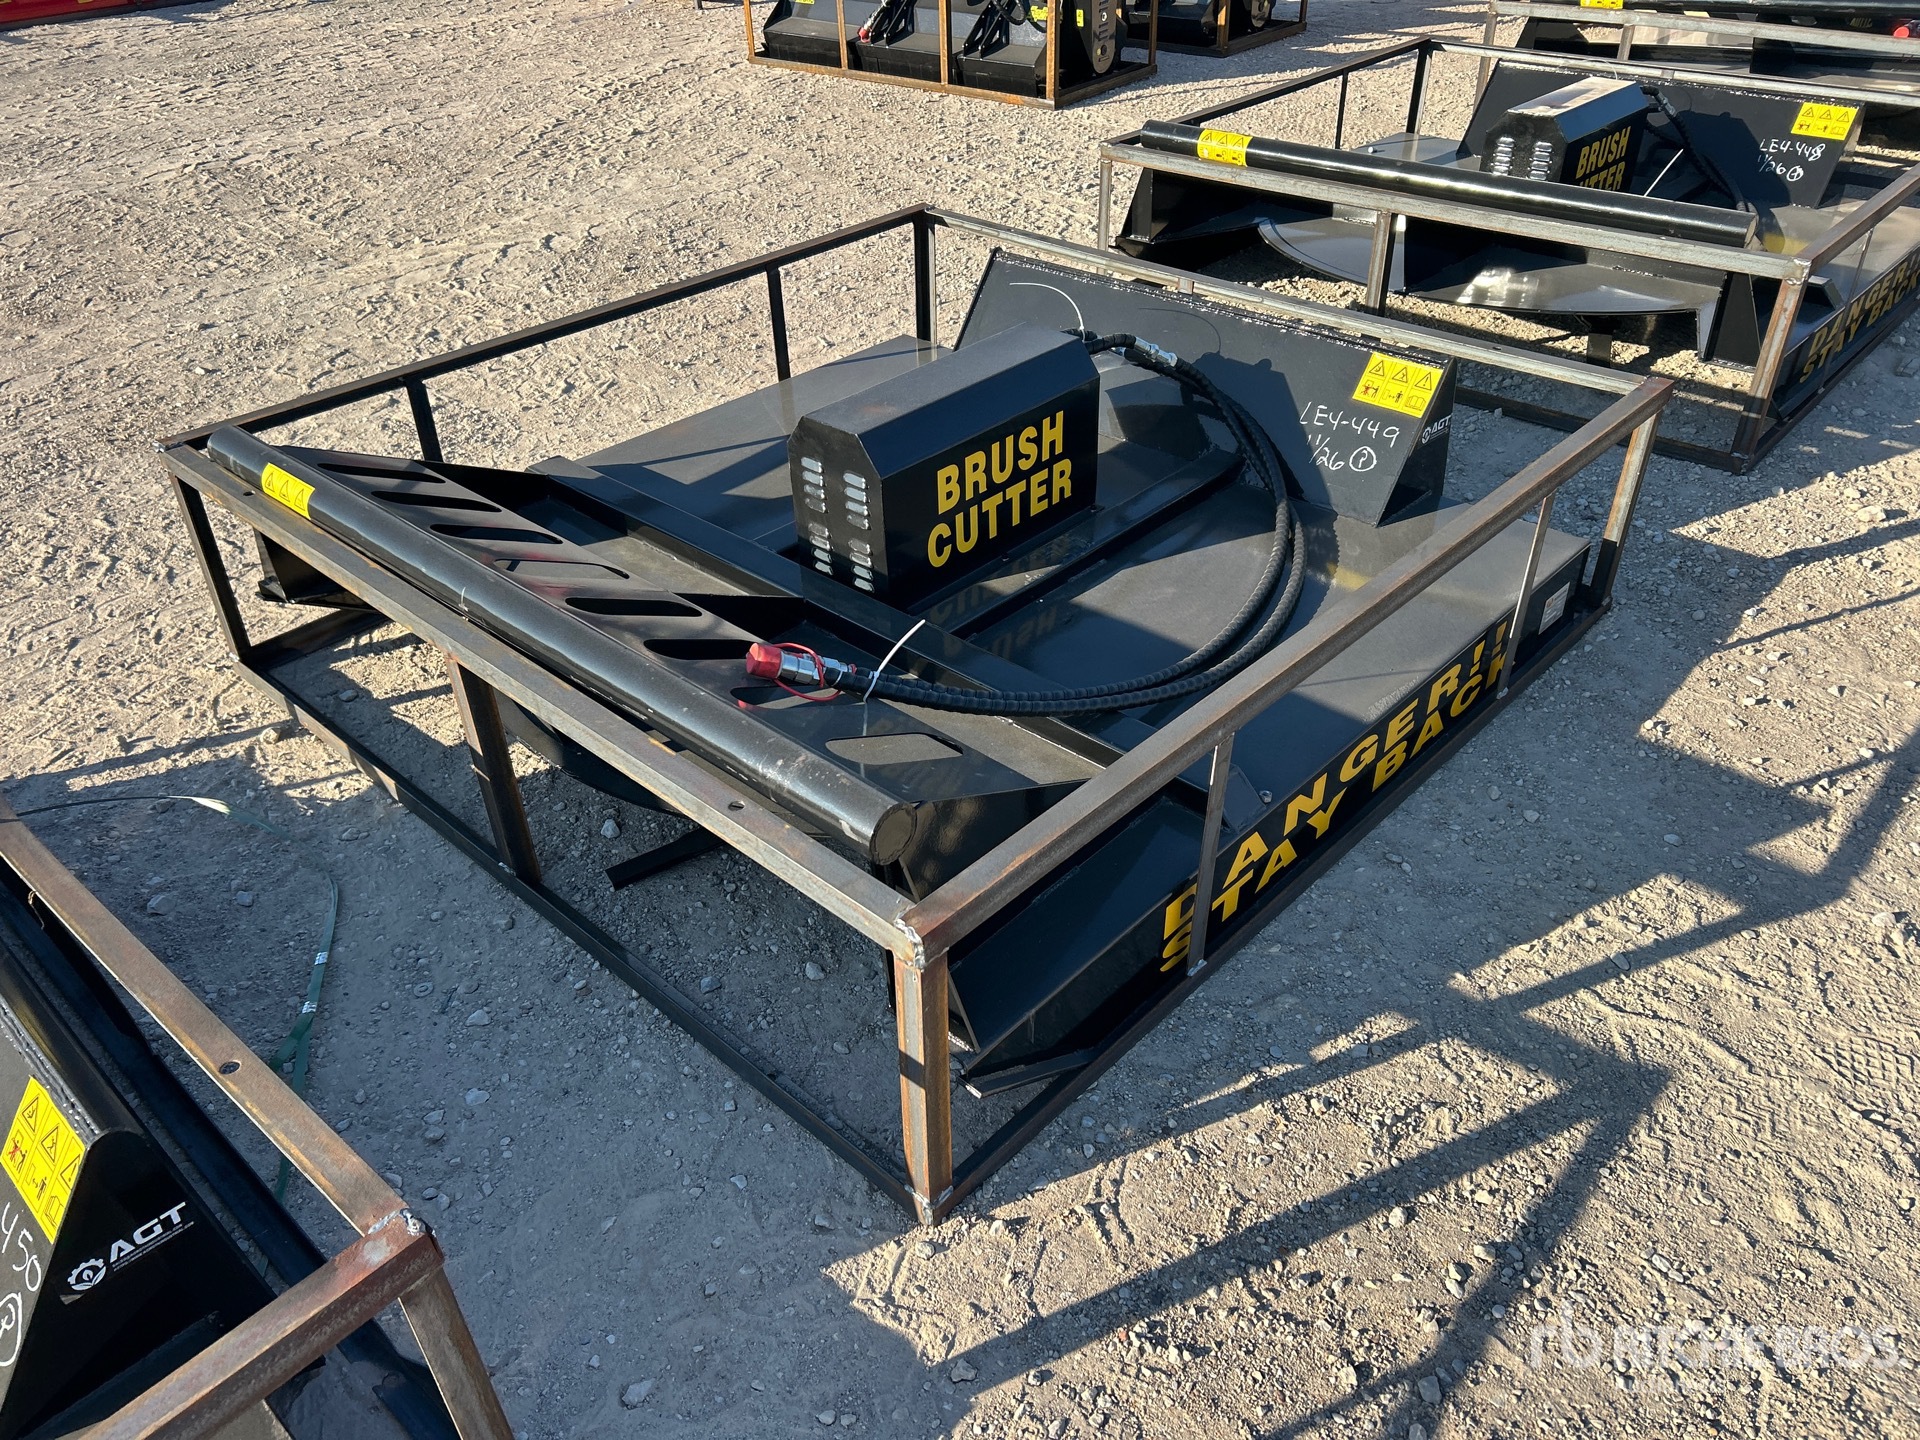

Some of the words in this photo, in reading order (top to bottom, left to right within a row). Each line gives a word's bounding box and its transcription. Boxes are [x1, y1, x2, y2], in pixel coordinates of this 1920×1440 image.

[1576, 126, 1631, 179] BRUSH
[1866, 270, 1920, 328] BACK
[1800, 315, 1864, 383] STAY
[1299, 401, 1400, 448] LE4-449
[1431, 415, 1452, 434] AGT
[937, 410, 1064, 515] BRUSH
[927, 458, 1072, 568] CUTTER
[1372, 650, 1516, 793] BACK
[1163, 620, 1508, 941] DANGER!!
[1160, 787, 1348, 973] STAY
[109, 1201, 187, 1264] AGT
